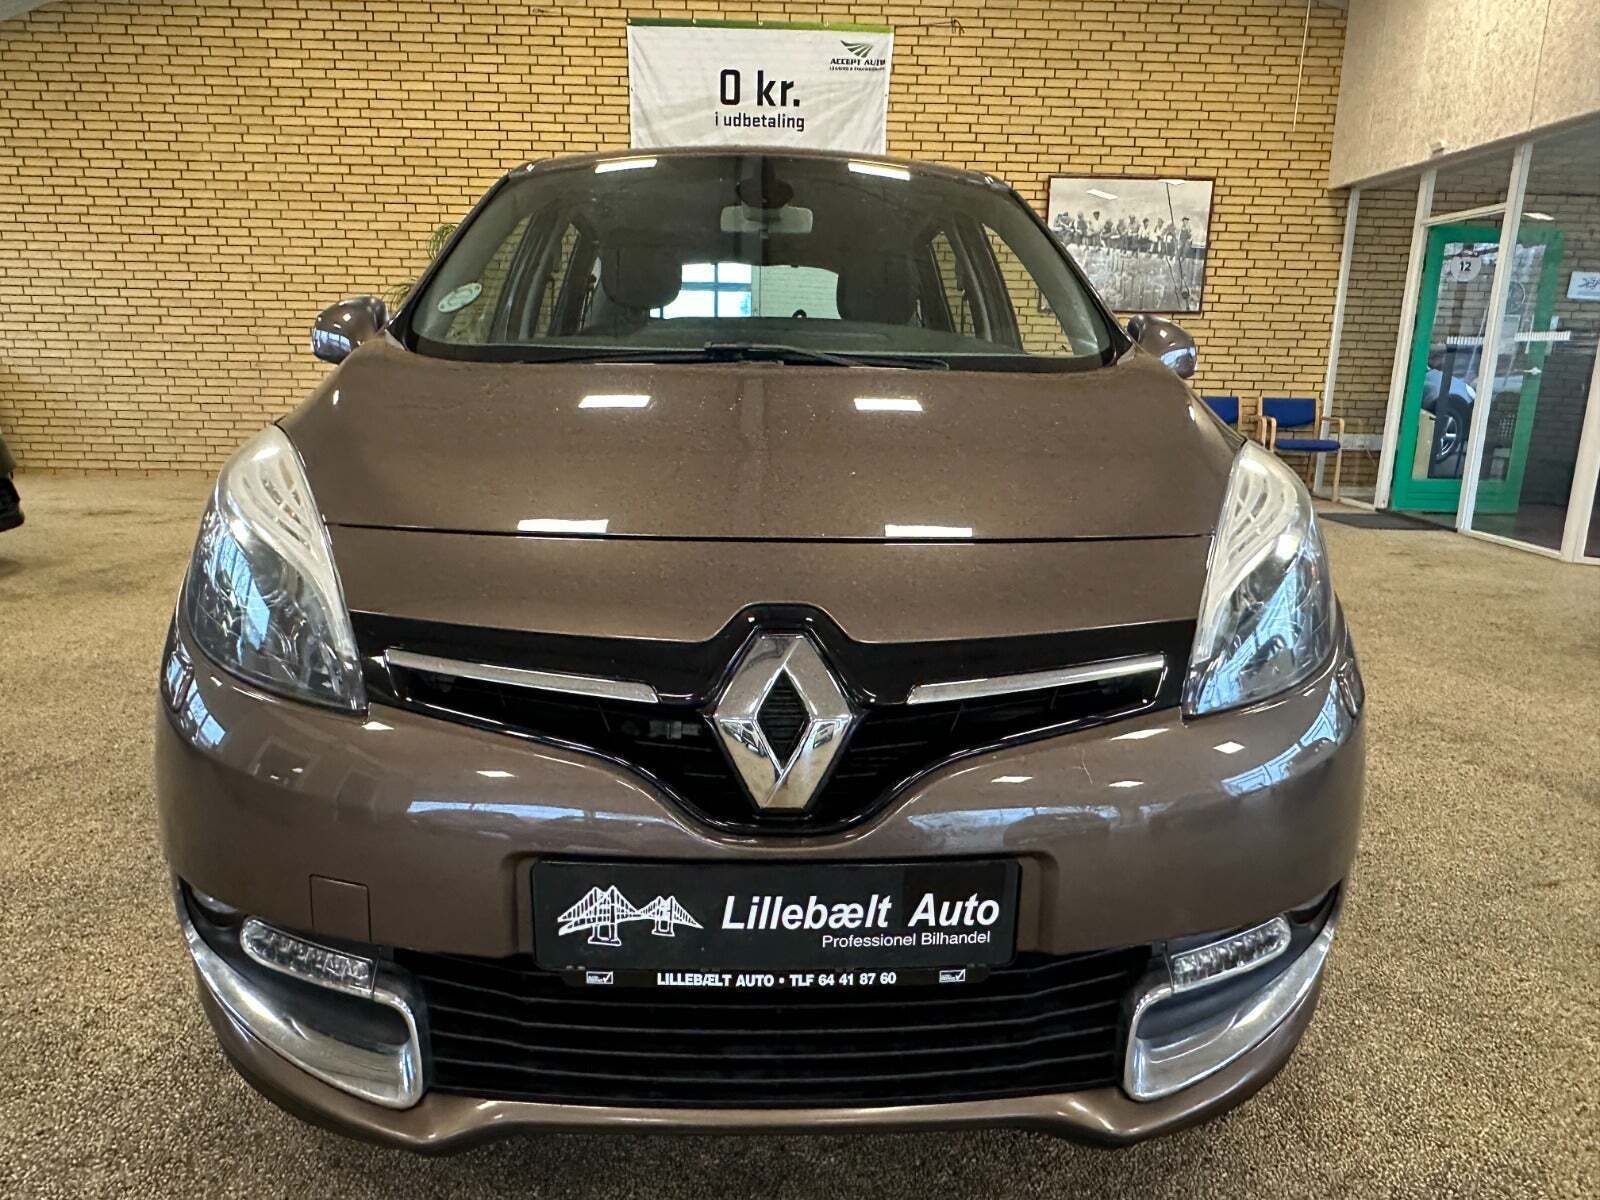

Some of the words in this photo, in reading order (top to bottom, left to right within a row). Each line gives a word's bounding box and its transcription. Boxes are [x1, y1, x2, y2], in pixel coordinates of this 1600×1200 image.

[720, 68, 741, 106] 0
[756, 69, 801, 107] kr.
[714, 111, 719, 127] i
[723, 112, 805, 133] udbetaling
[1460, 261, 1472, 272] 12
[721, 894, 893, 930] Lillebælt
[907, 892, 1000, 927] Auto
[822, 932, 917, 949] Professionel
[920, 930, 991, 947] Bilhandel
[656, 972, 733, 987] LILLEBÆLT
[735, 974, 775, 988] AUTO
[789, 973, 815, 987] TLF
[817, 973, 835, 987] 64
[838, 973, 854, 986] 41
[859, 972, 877, 986] 87
[879, 971, 897, 985] 60
